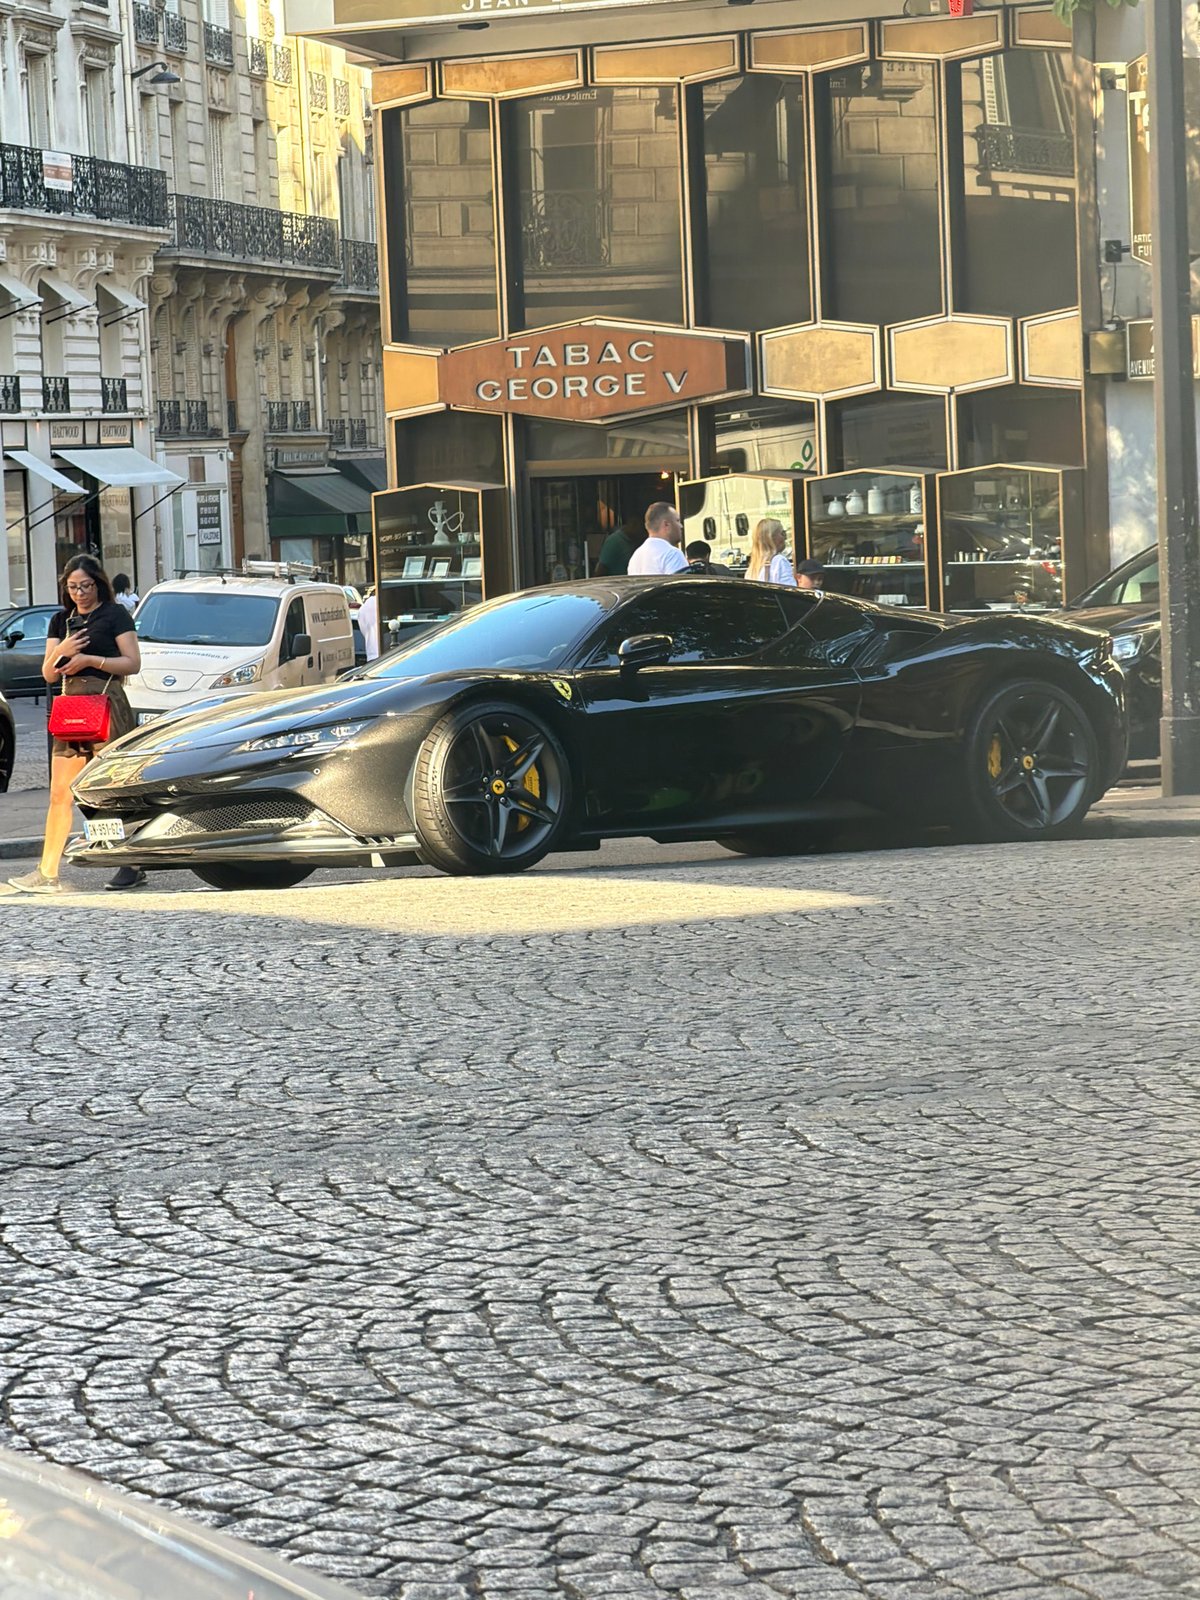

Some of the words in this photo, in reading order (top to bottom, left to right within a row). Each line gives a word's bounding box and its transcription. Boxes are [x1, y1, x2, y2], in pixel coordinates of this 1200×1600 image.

[506, 340, 655, 369] TABAC
[475, 372, 646, 402] GEORGE
[663, 370, 689, 394] V
[52, 425, 80, 438] HARTWOOD
[102, 424, 128, 437] HARTWOOD
